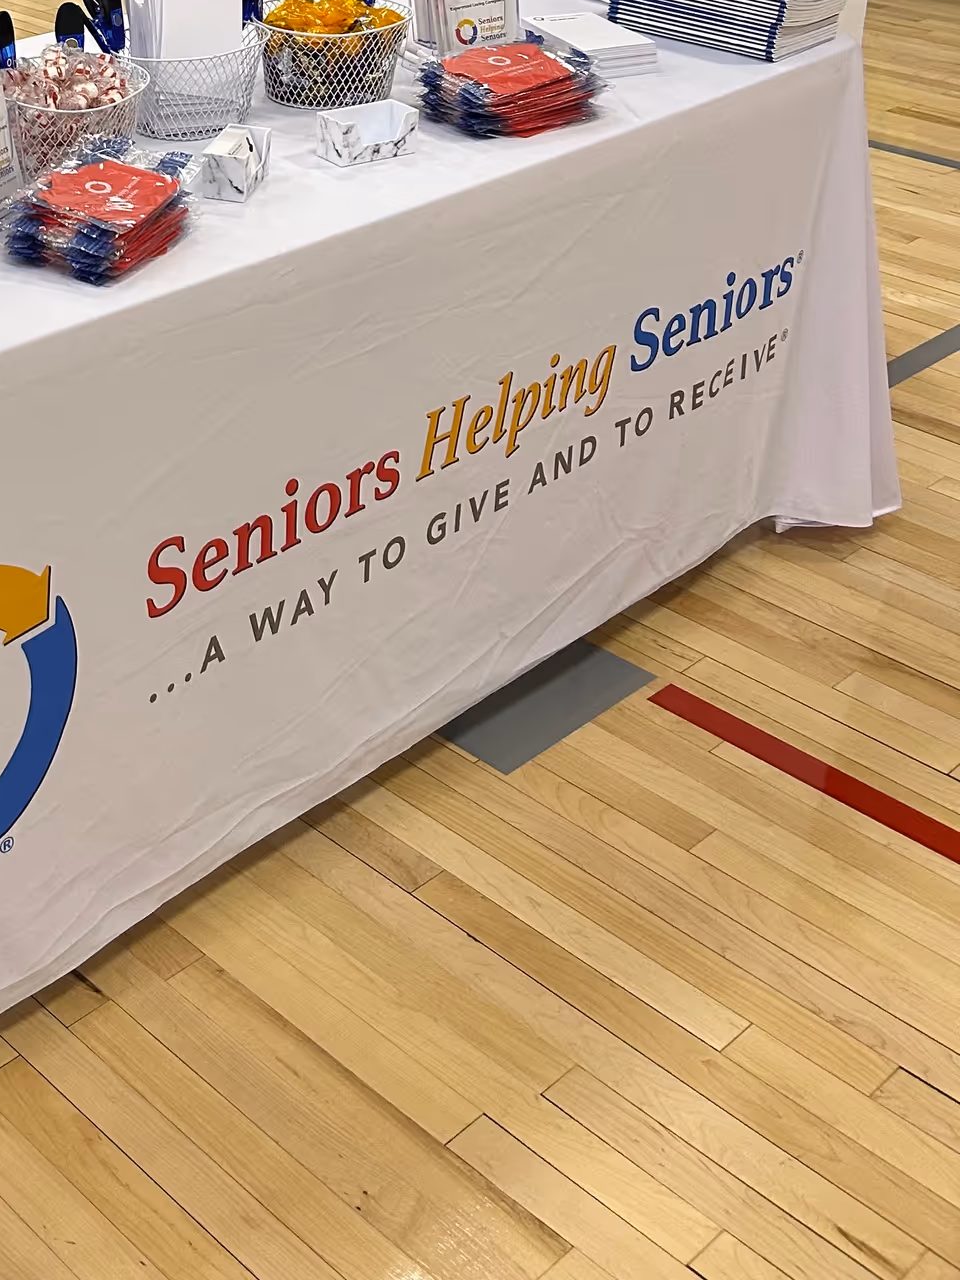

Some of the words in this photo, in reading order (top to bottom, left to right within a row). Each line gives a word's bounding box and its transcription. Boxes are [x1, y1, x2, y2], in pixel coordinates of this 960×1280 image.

[478, 15, 504, 25] Seniors
[480, 32, 507, 42] Seniors
[146, 449, 401, 619] Seniors
[415, 343, 617, 483] Helping
[247, 569, 339, 642] WAY
[358, 535, 407, 584] TO
[425, 479, 511, 547] GIVE
[526, 434, 598, 496] AND
[614, 407, 653, 449] TO
